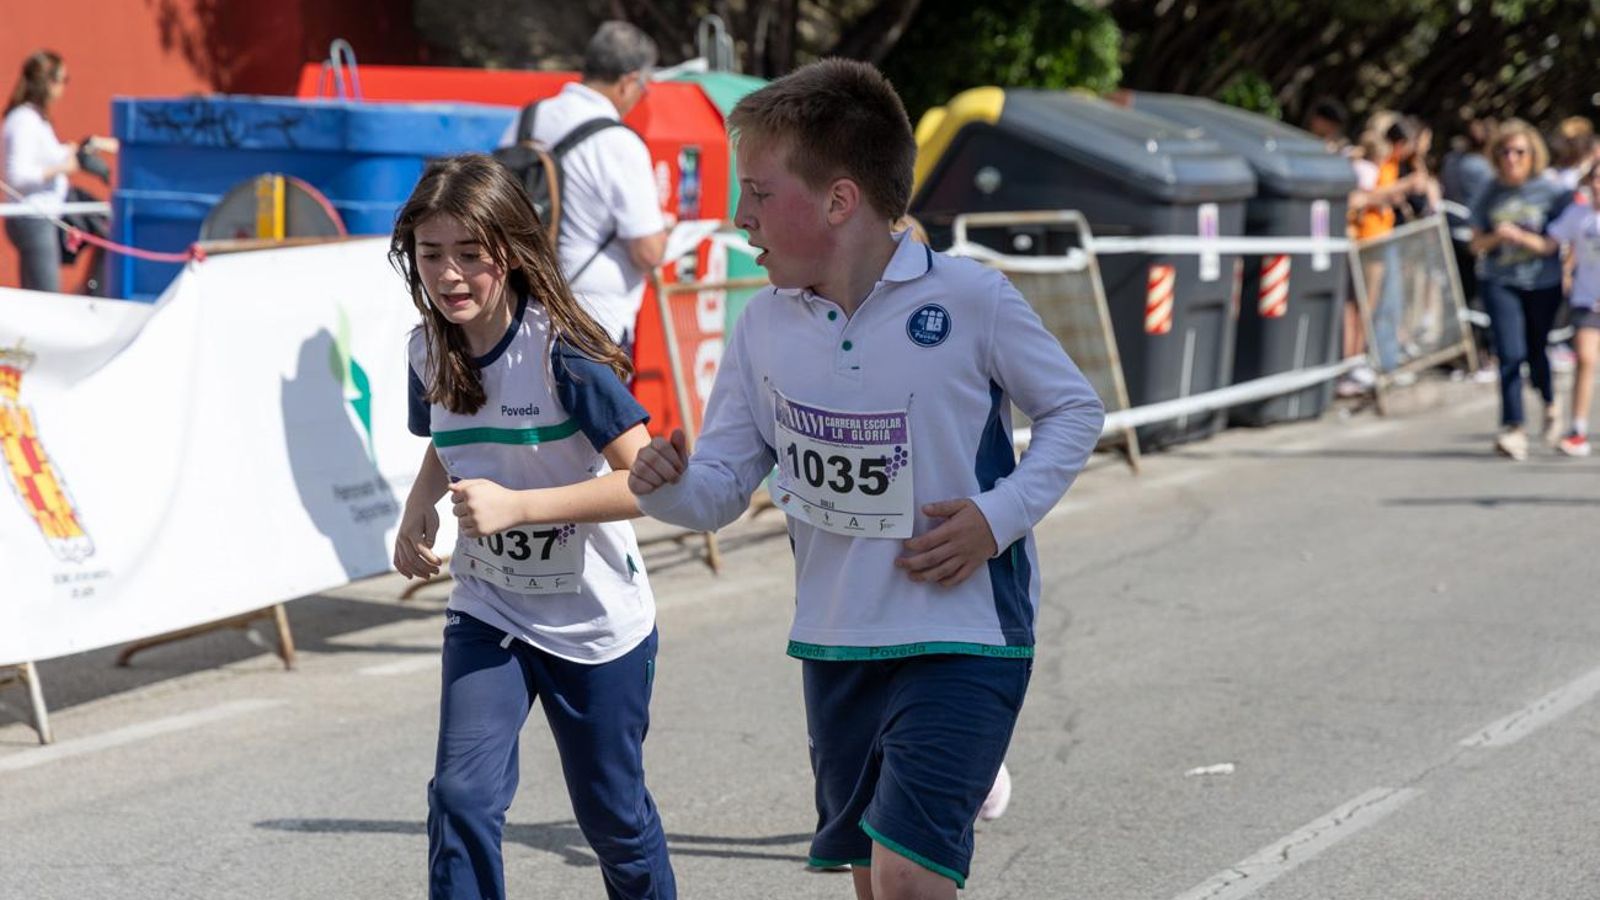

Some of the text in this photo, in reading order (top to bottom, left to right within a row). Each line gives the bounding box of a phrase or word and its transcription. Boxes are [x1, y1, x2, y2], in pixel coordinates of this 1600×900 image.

[501, 403, 540, 417] Poveda
[825, 416, 861, 429] CARRERA
[864, 417, 901, 430] ESCOLAR
[832, 427, 891, 441] LA GLORIA
[787, 442, 889, 496] 1035
[869, 642, 927, 658] Poveda
